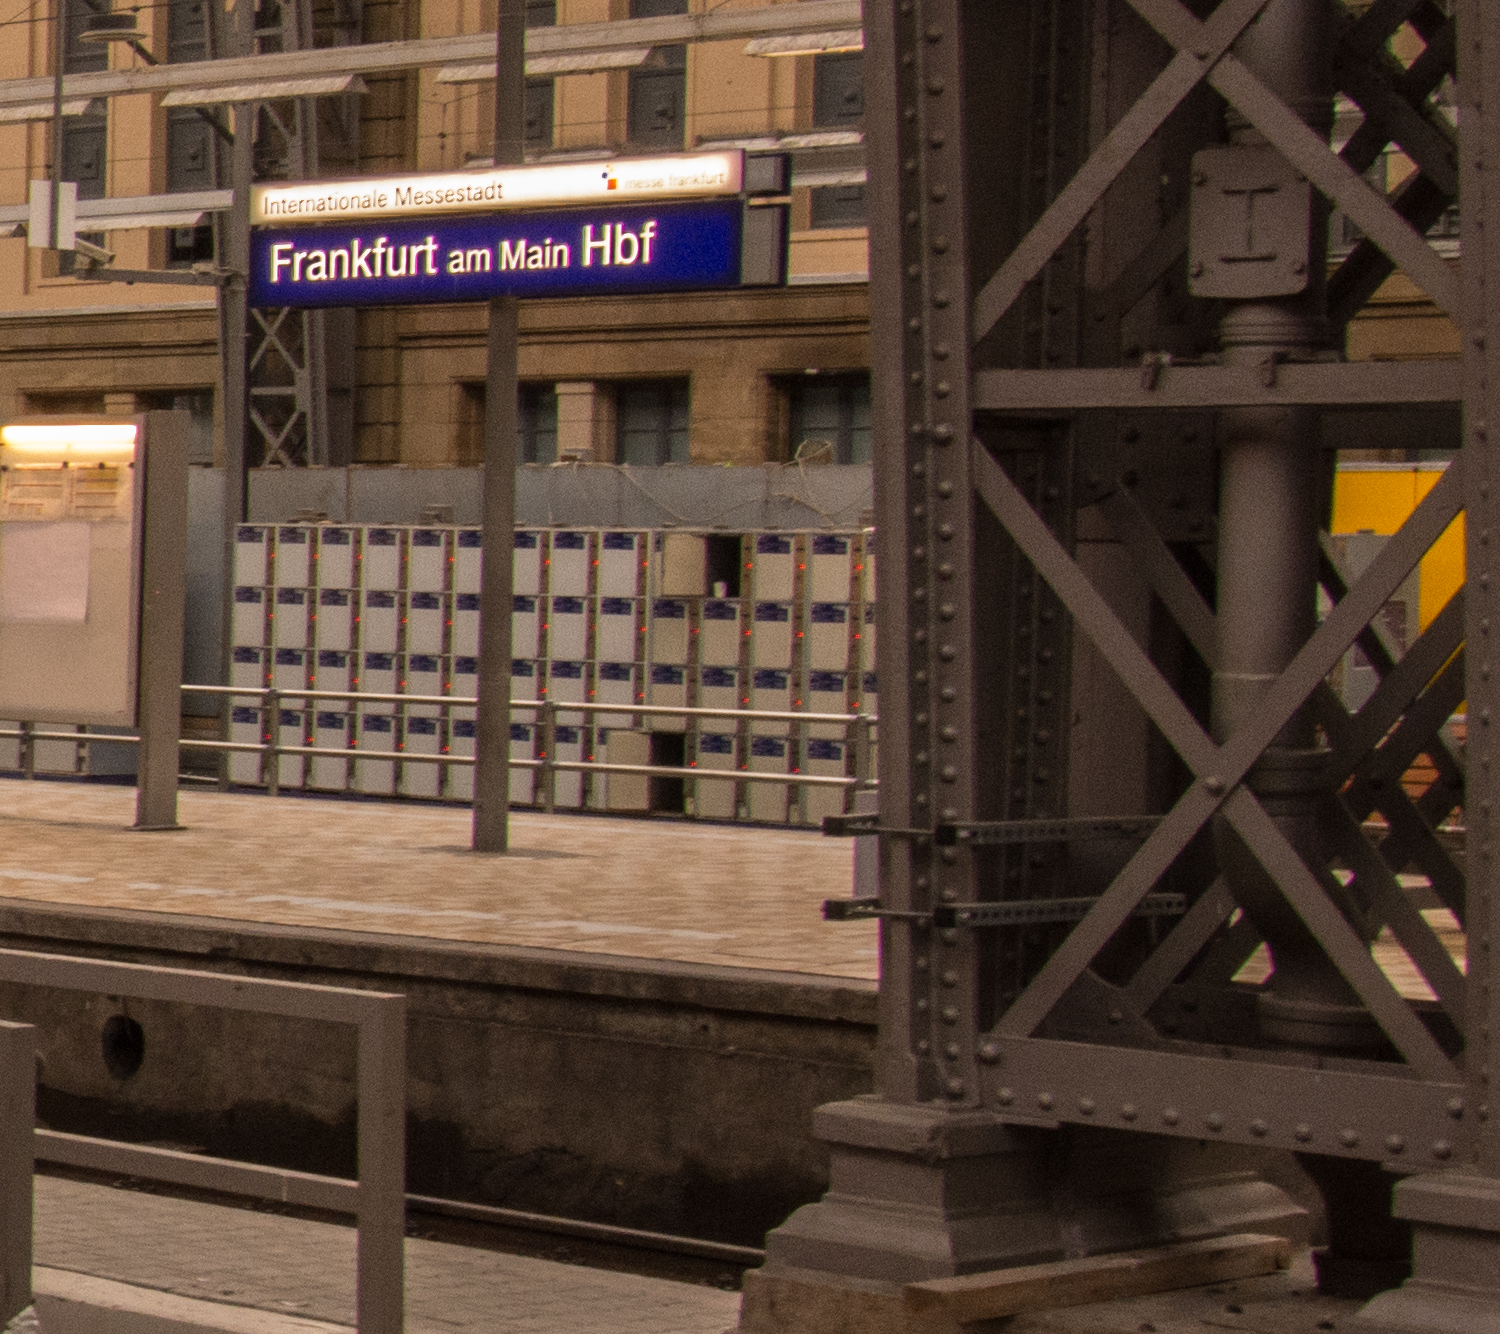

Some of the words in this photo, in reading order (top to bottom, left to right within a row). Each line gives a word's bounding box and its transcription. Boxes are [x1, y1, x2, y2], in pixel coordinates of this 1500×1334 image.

[625, 177, 665, 189] messe
[667, 170, 725, 186] frankfurt
[263, 188, 389, 215] Internationale
[395, 181, 504, 208] Messestadt
[269, 235, 438, 283] Frankfurt
[447, 247, 491, 273] am
[500, 237, 570, 271] Main
[582, 220, 657, 266] Hbf
